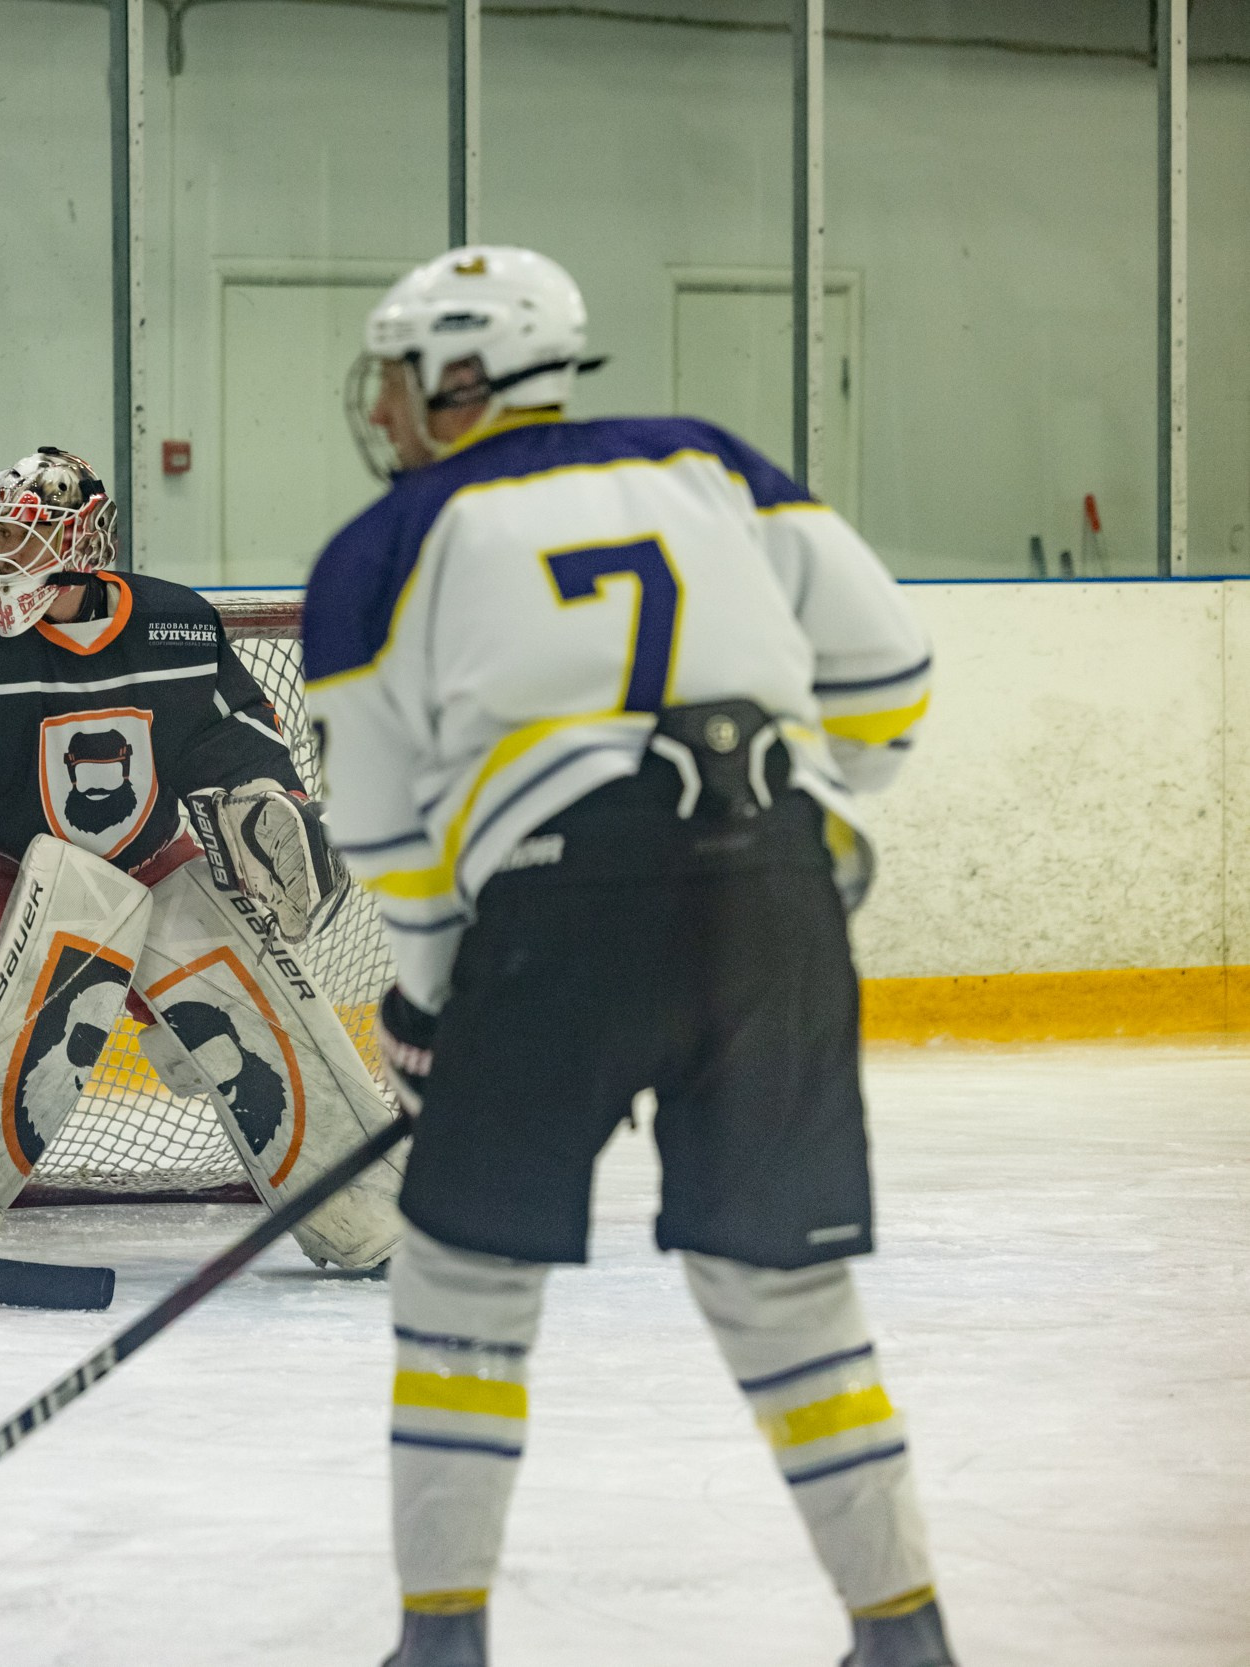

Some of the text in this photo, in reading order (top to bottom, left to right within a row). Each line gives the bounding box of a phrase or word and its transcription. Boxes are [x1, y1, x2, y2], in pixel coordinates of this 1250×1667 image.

[148, 622, 189, 631] ЛЕДОВАЯ
[538, 533, 685, 712] 7
[193, 801, 229, 886] BAUER
[230, 896, 316, 1001] BAUER
